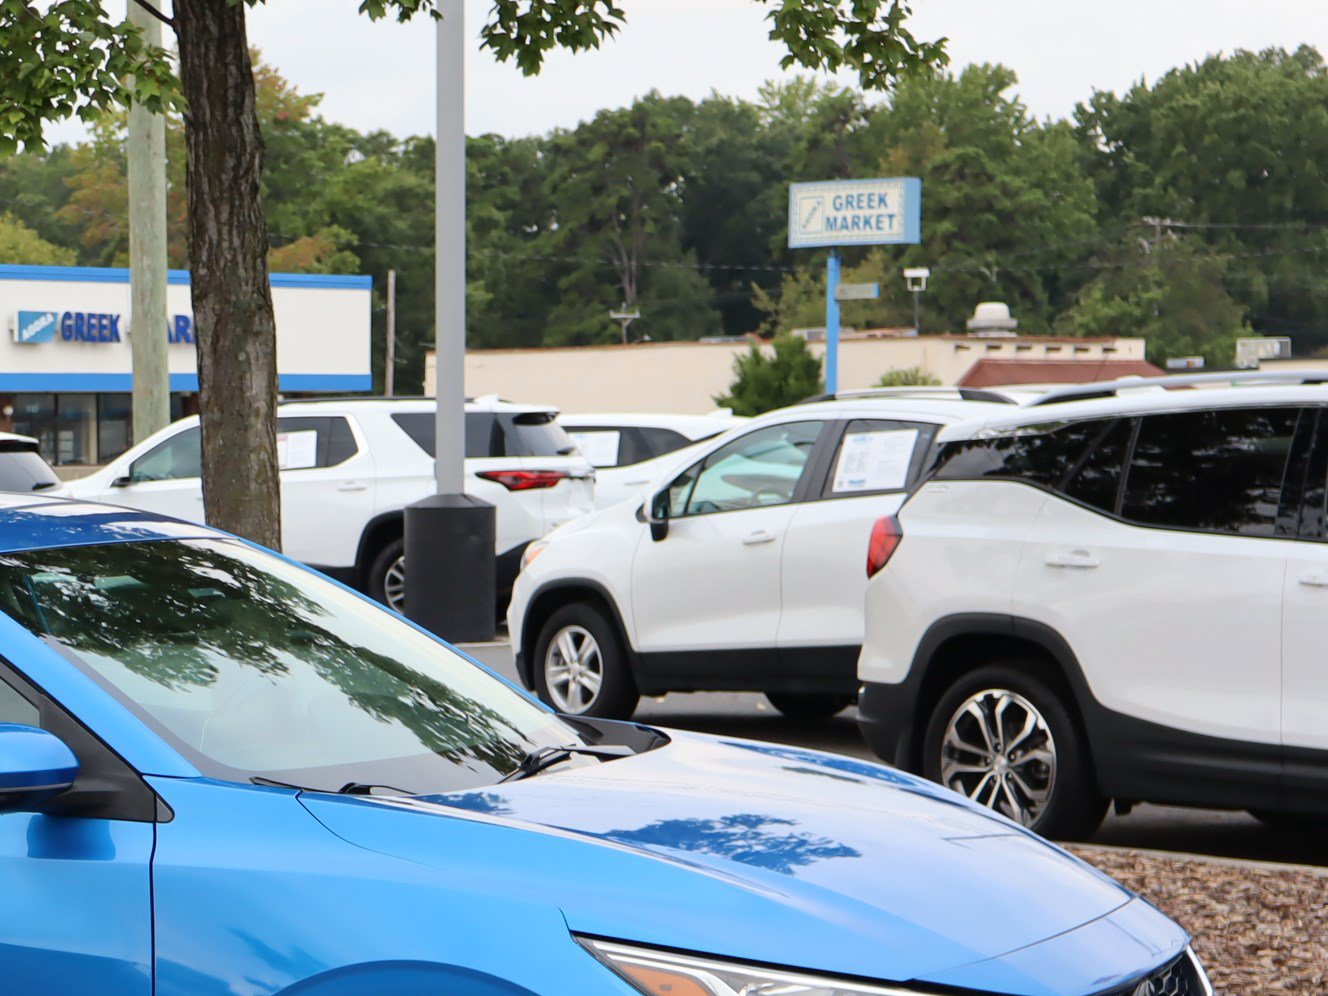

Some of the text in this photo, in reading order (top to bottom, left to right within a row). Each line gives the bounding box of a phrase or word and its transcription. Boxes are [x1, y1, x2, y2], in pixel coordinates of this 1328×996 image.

[832, 193, 888, 212] GREEK
[825, 213, 896, 231] MARKET
[61, 311, 121, 343] GREEK
